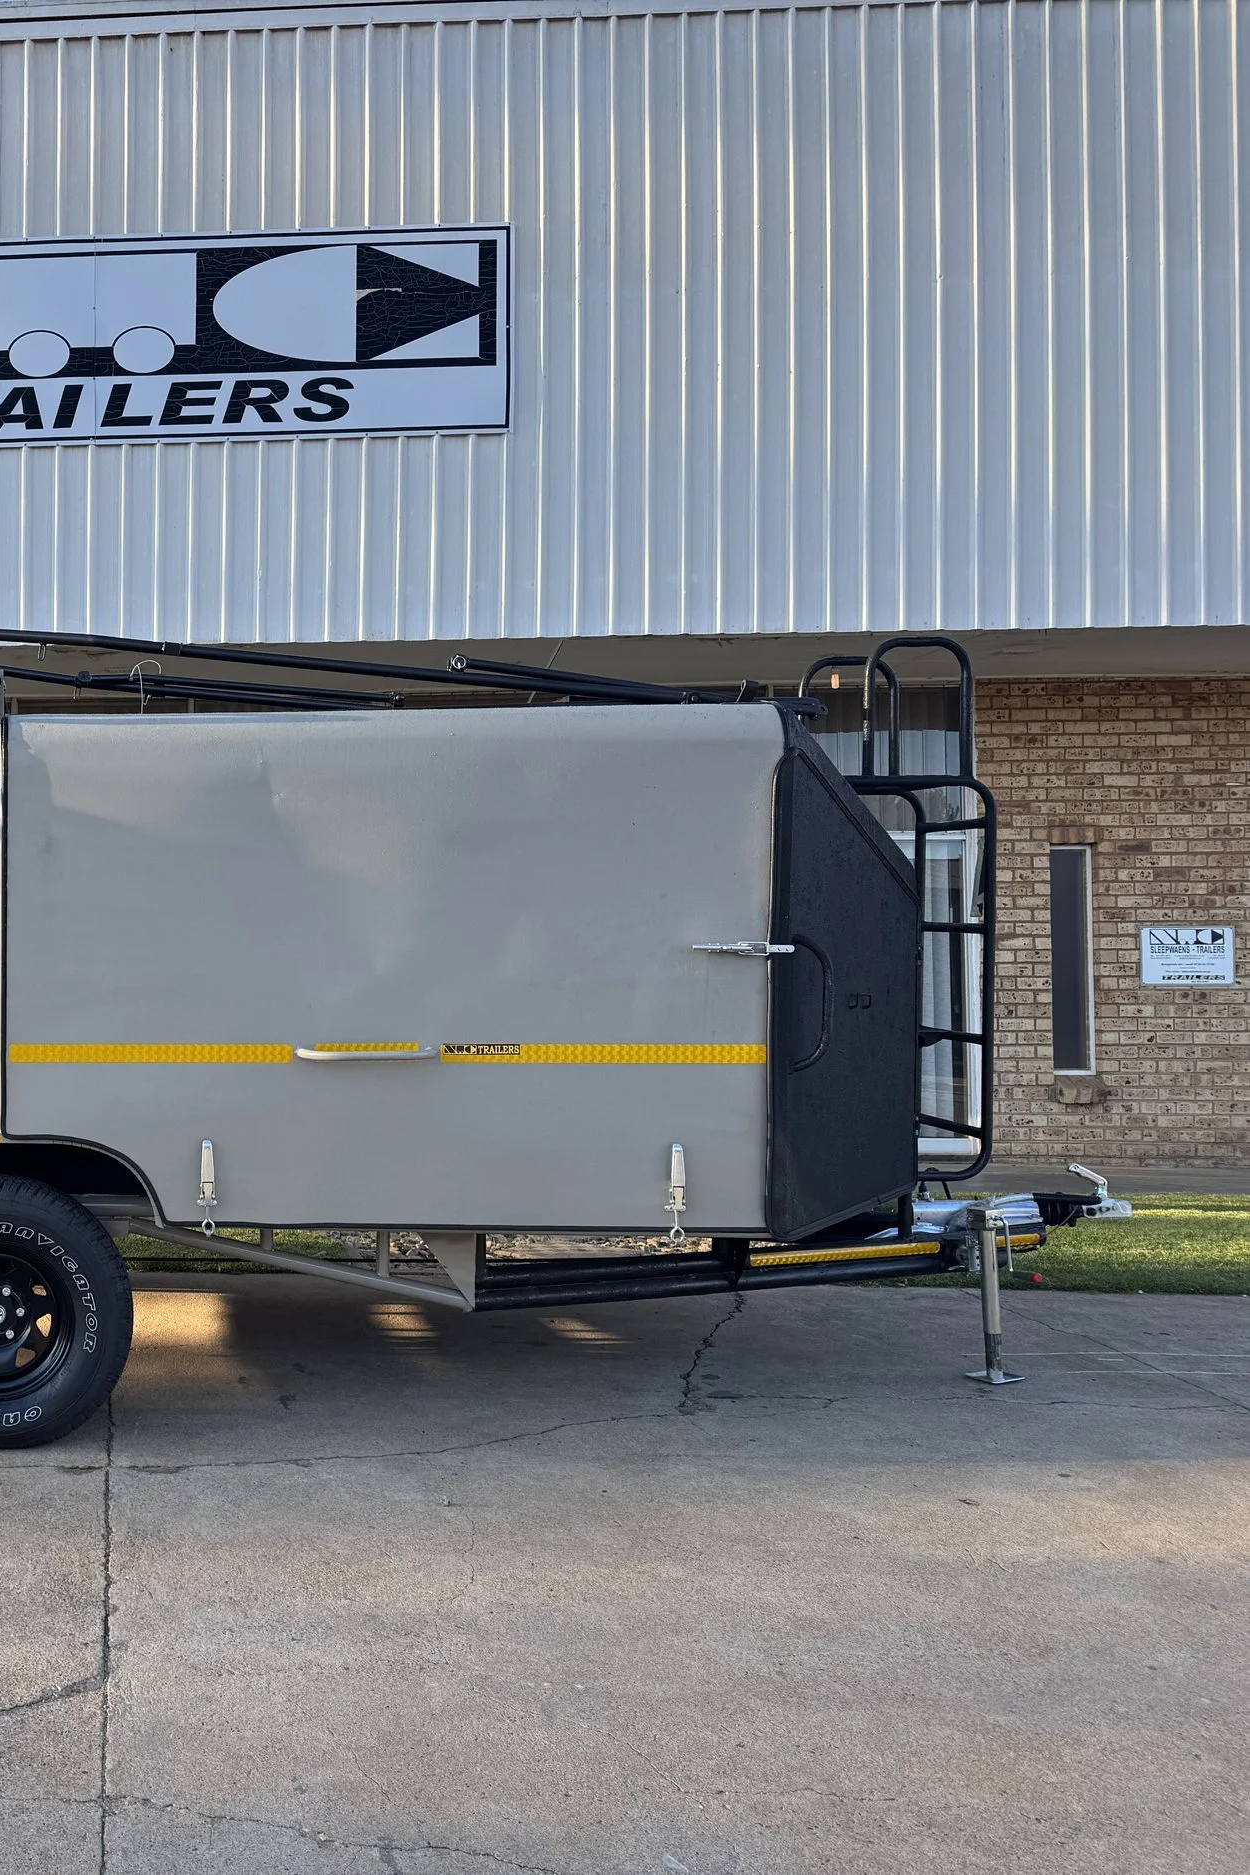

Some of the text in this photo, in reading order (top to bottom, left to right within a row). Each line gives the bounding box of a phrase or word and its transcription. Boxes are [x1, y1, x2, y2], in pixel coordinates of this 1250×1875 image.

[1150, 945, 1191, 954] SLEEPWAENS
[1196, 945, 1225, 954] TRAILERS
[478, 1045, 520, 1055] TRAILERS
